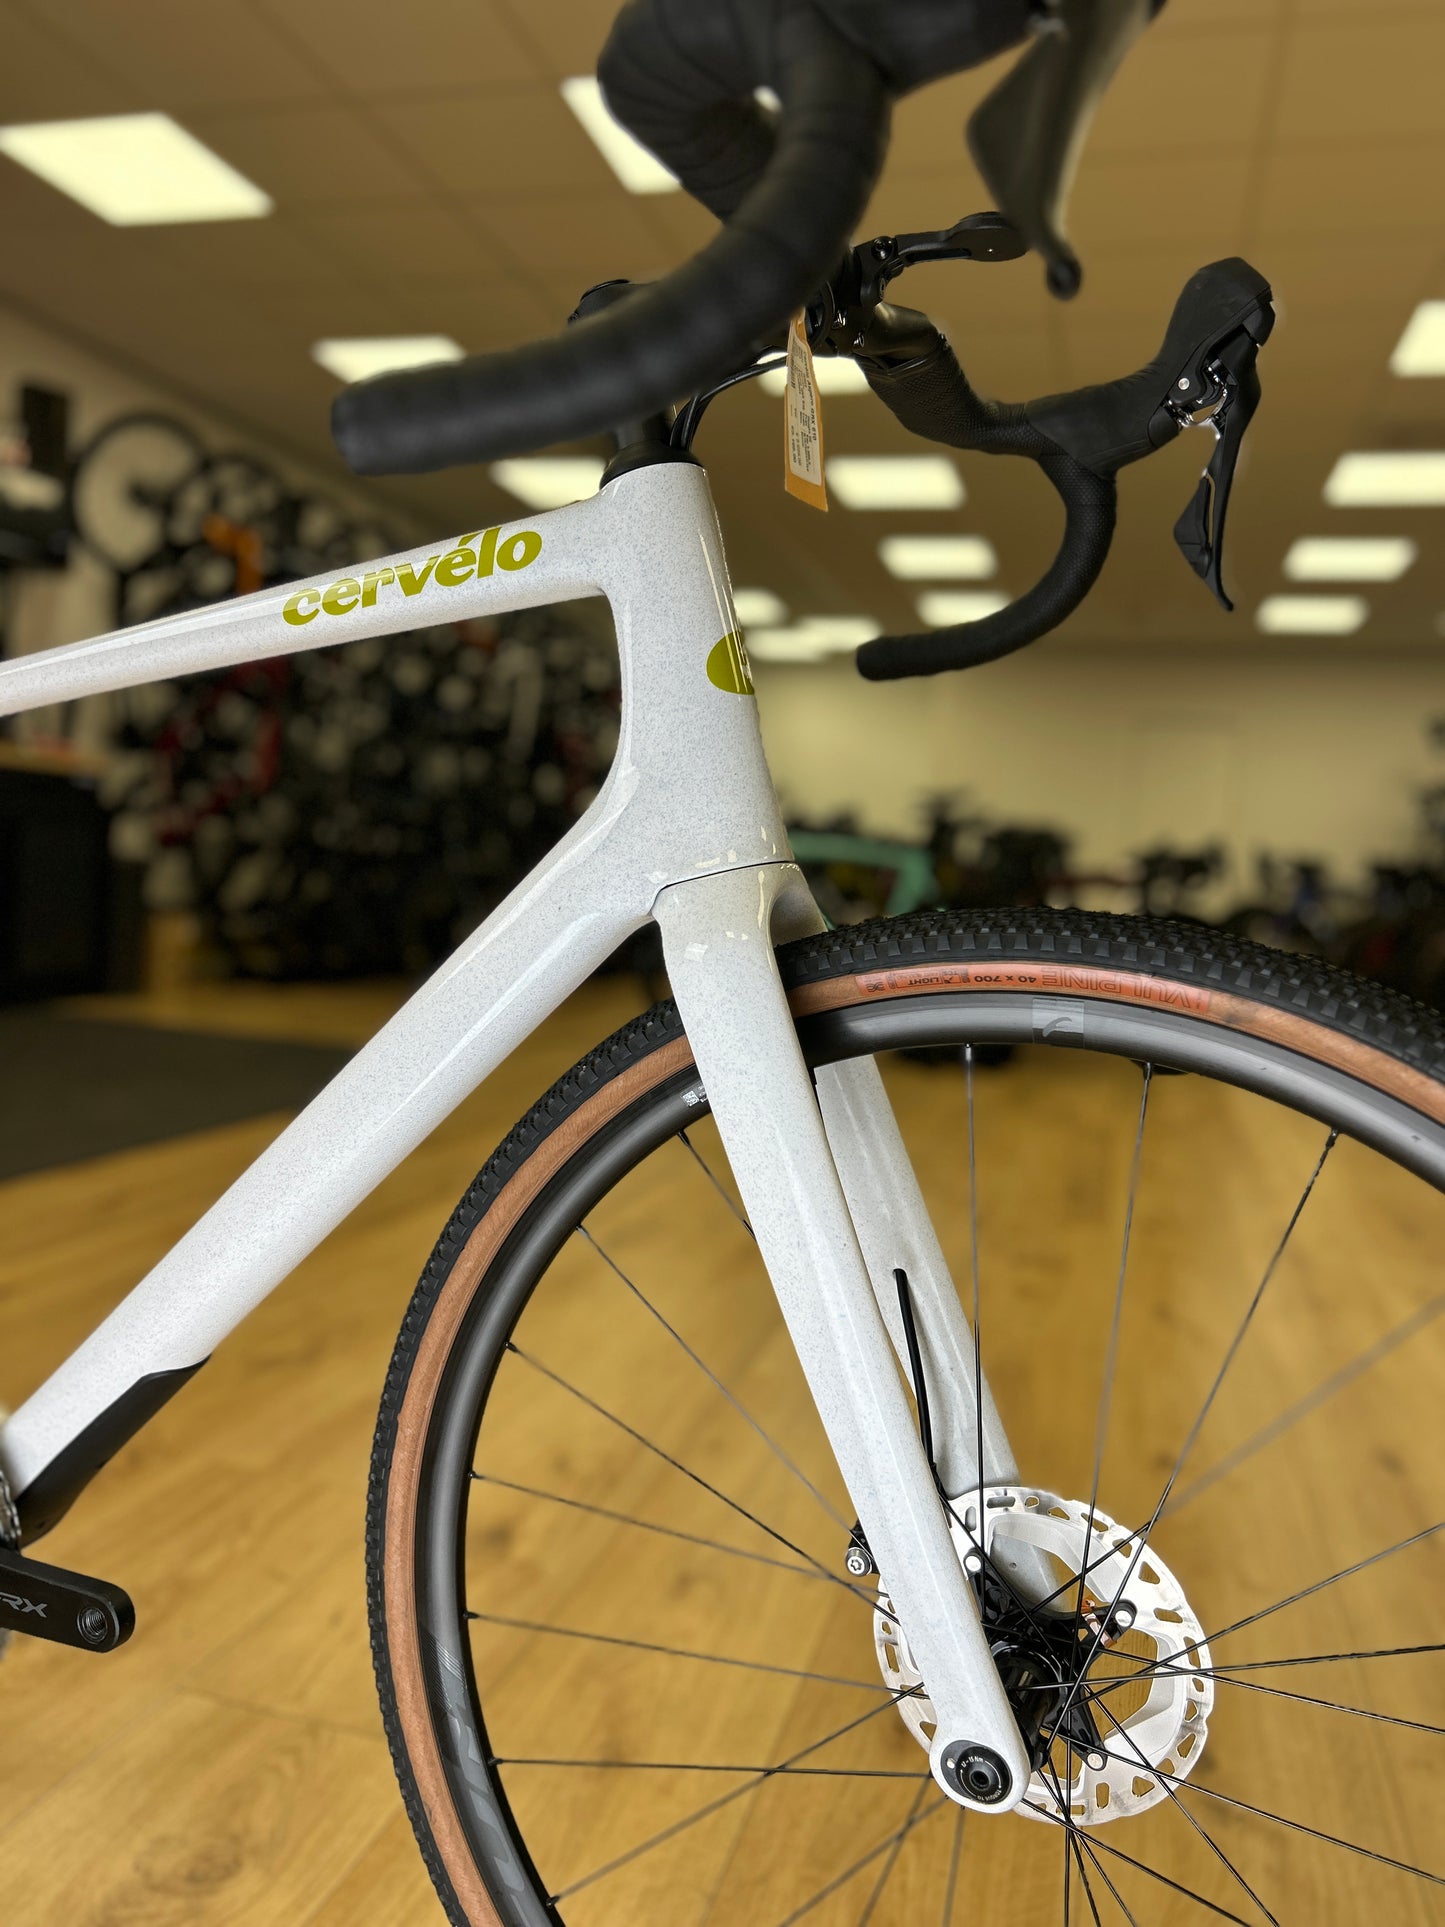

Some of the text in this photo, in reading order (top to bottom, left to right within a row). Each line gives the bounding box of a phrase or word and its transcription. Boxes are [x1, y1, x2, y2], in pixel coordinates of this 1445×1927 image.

[282, 526, 543, 626] cervélo
[907, 977, 940, 986] LIGHT
[974, 975, 1002, 983] 700
[1018, 975, 1037, 983] 40
[1041, 966, 1192, 1010] VULPINE
